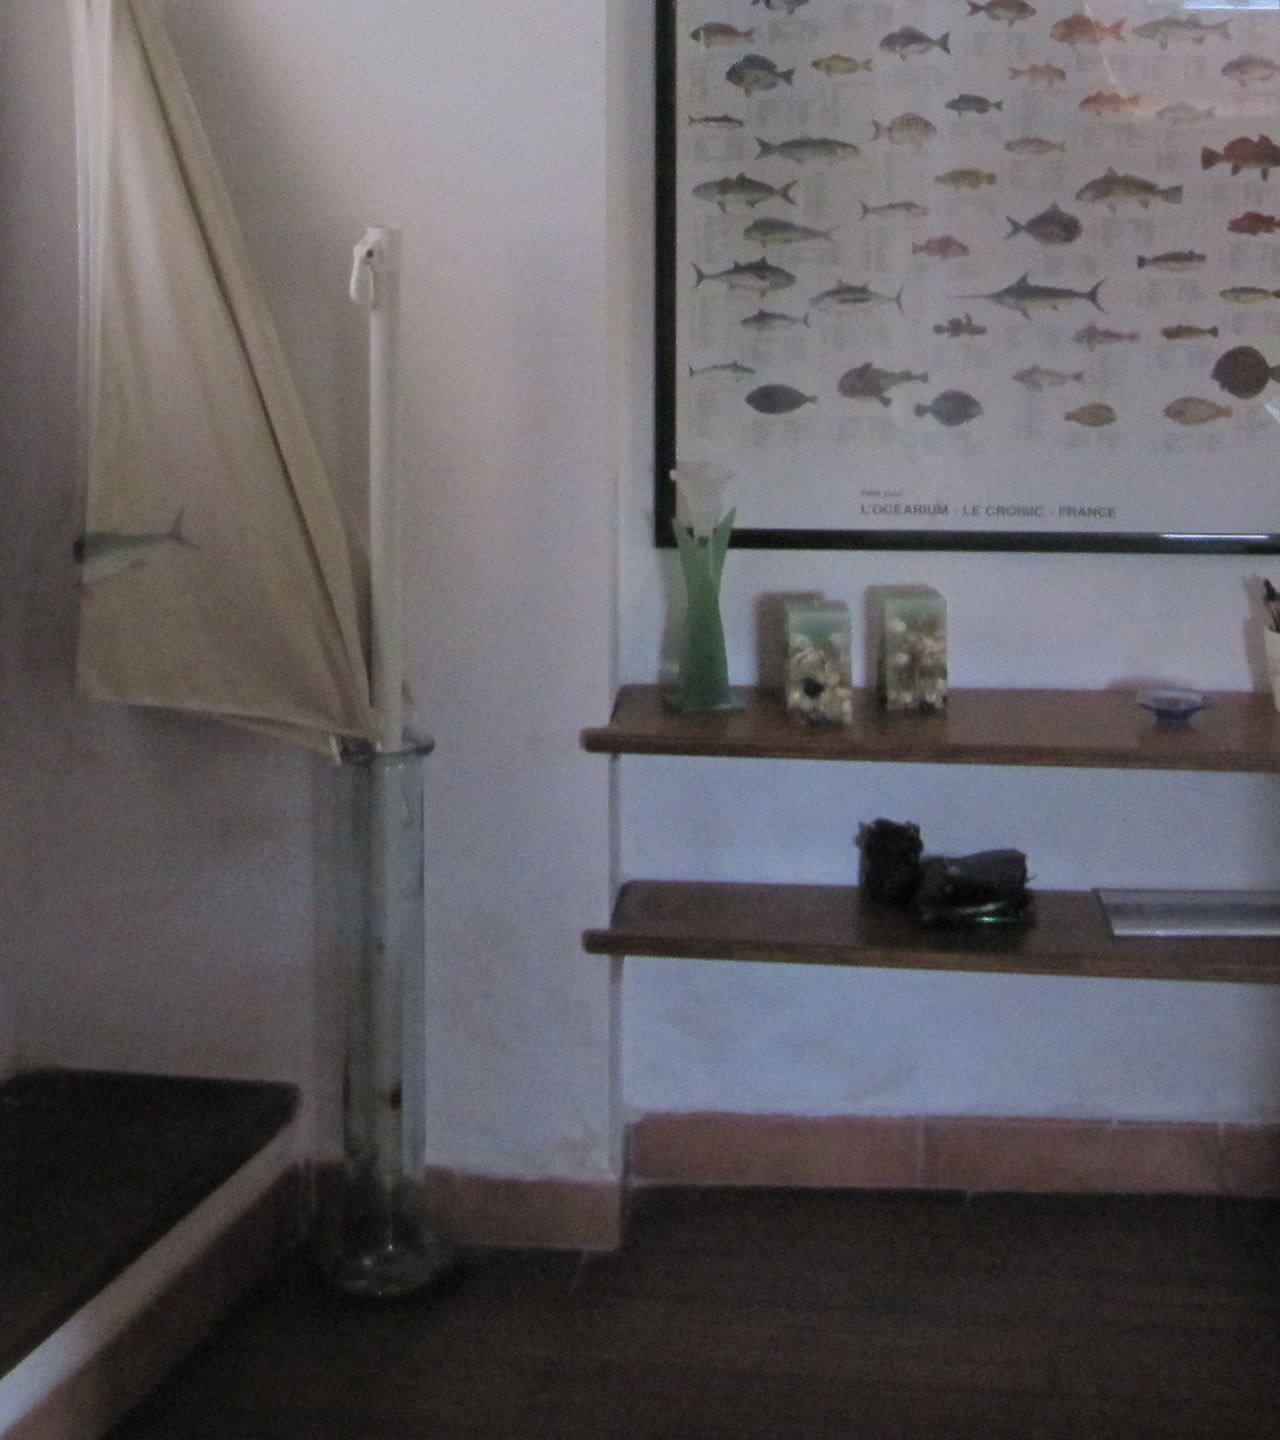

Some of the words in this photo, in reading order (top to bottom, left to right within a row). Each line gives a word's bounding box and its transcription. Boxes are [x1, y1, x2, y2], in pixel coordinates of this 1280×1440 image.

[962, 504, 980, 517] LE
[984, 505, 1044, 518] CROISIC
[1058, 505, 1117, 519] FRANCE
